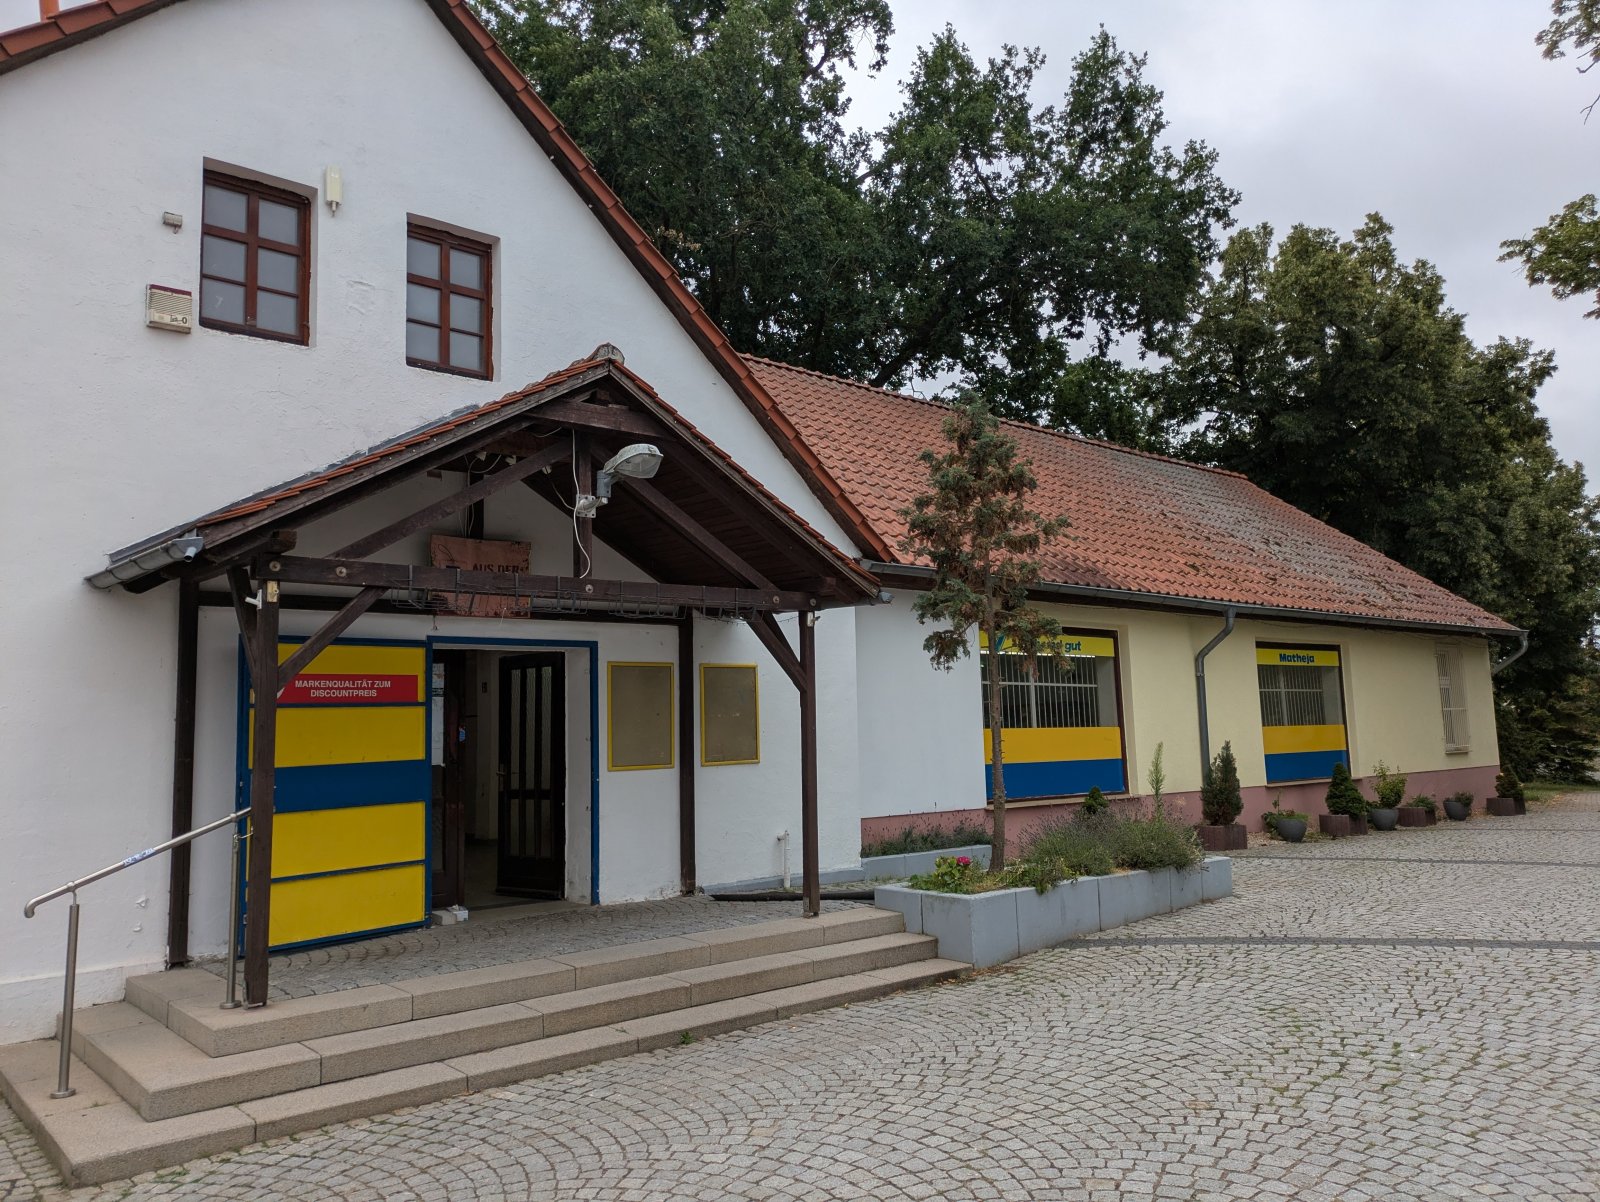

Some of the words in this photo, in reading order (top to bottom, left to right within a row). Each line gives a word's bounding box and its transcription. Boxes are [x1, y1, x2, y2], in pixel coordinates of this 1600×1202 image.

[472, 563, 494, 572] AUS
[1064, 640, 1082, 653] gut
[1279, 653, 1315, 664] Matheja
[295, 679, 372, 688] MARKENQUALITÄT
[374, 680, 391, 688] ZUM
[310, 689, 377, 697] DISCOUNTPREIS
